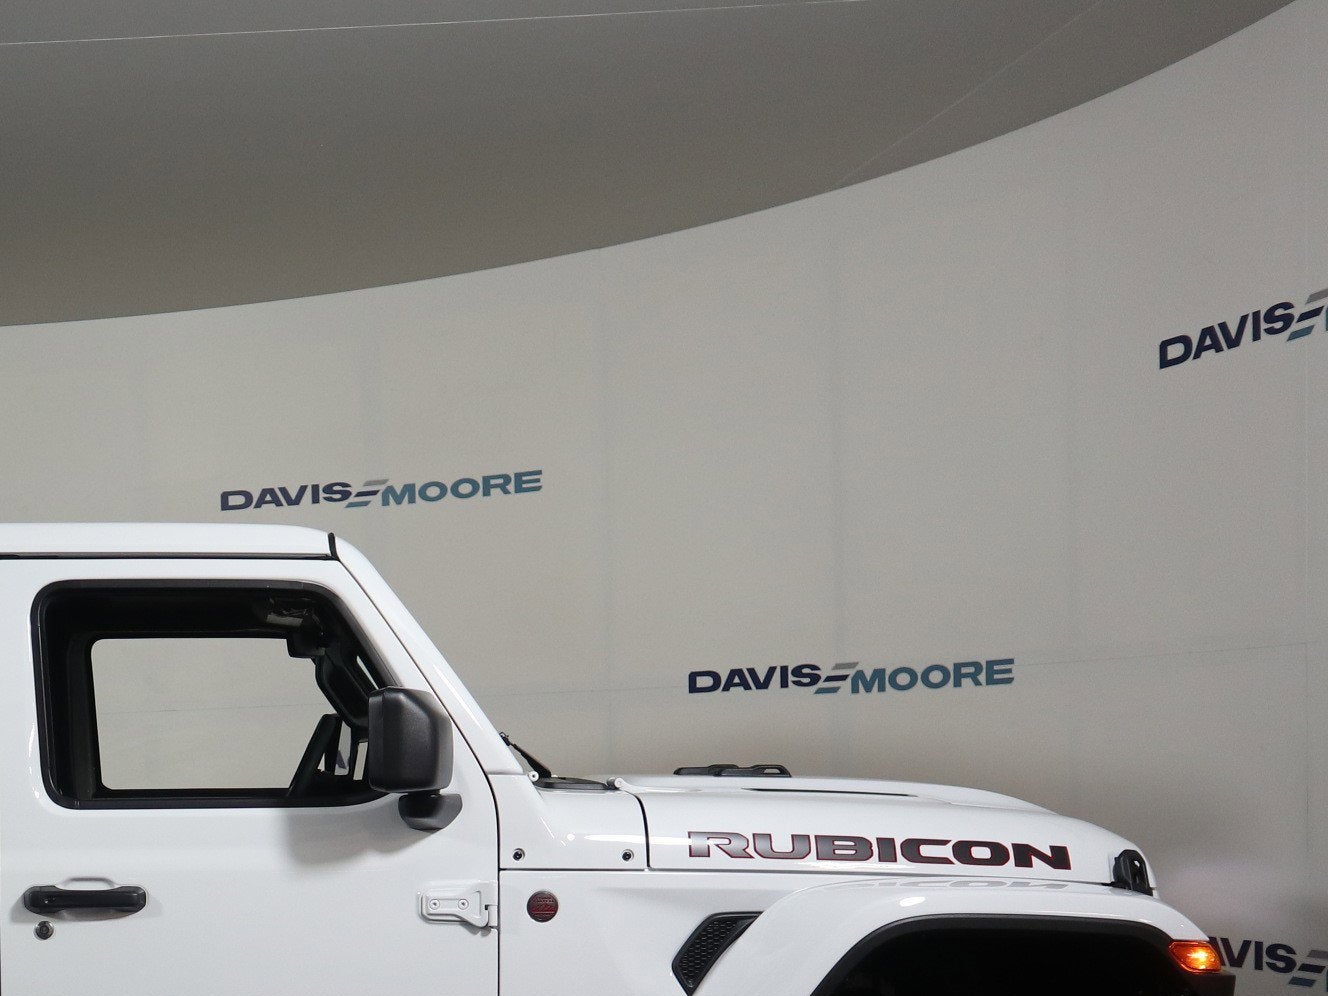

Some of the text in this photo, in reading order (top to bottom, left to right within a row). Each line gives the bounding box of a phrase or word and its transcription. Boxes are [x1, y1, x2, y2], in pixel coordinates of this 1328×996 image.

[1159, 301, 1295, 370] DAVIS
[219, 469, 544, 512] DAVIS MOORE
[687, 657, 1015, 694] DAVIS MOORE
[687, 830, 1073, 871] RUBICON
[1209, 936, 1298, 974] VIS
